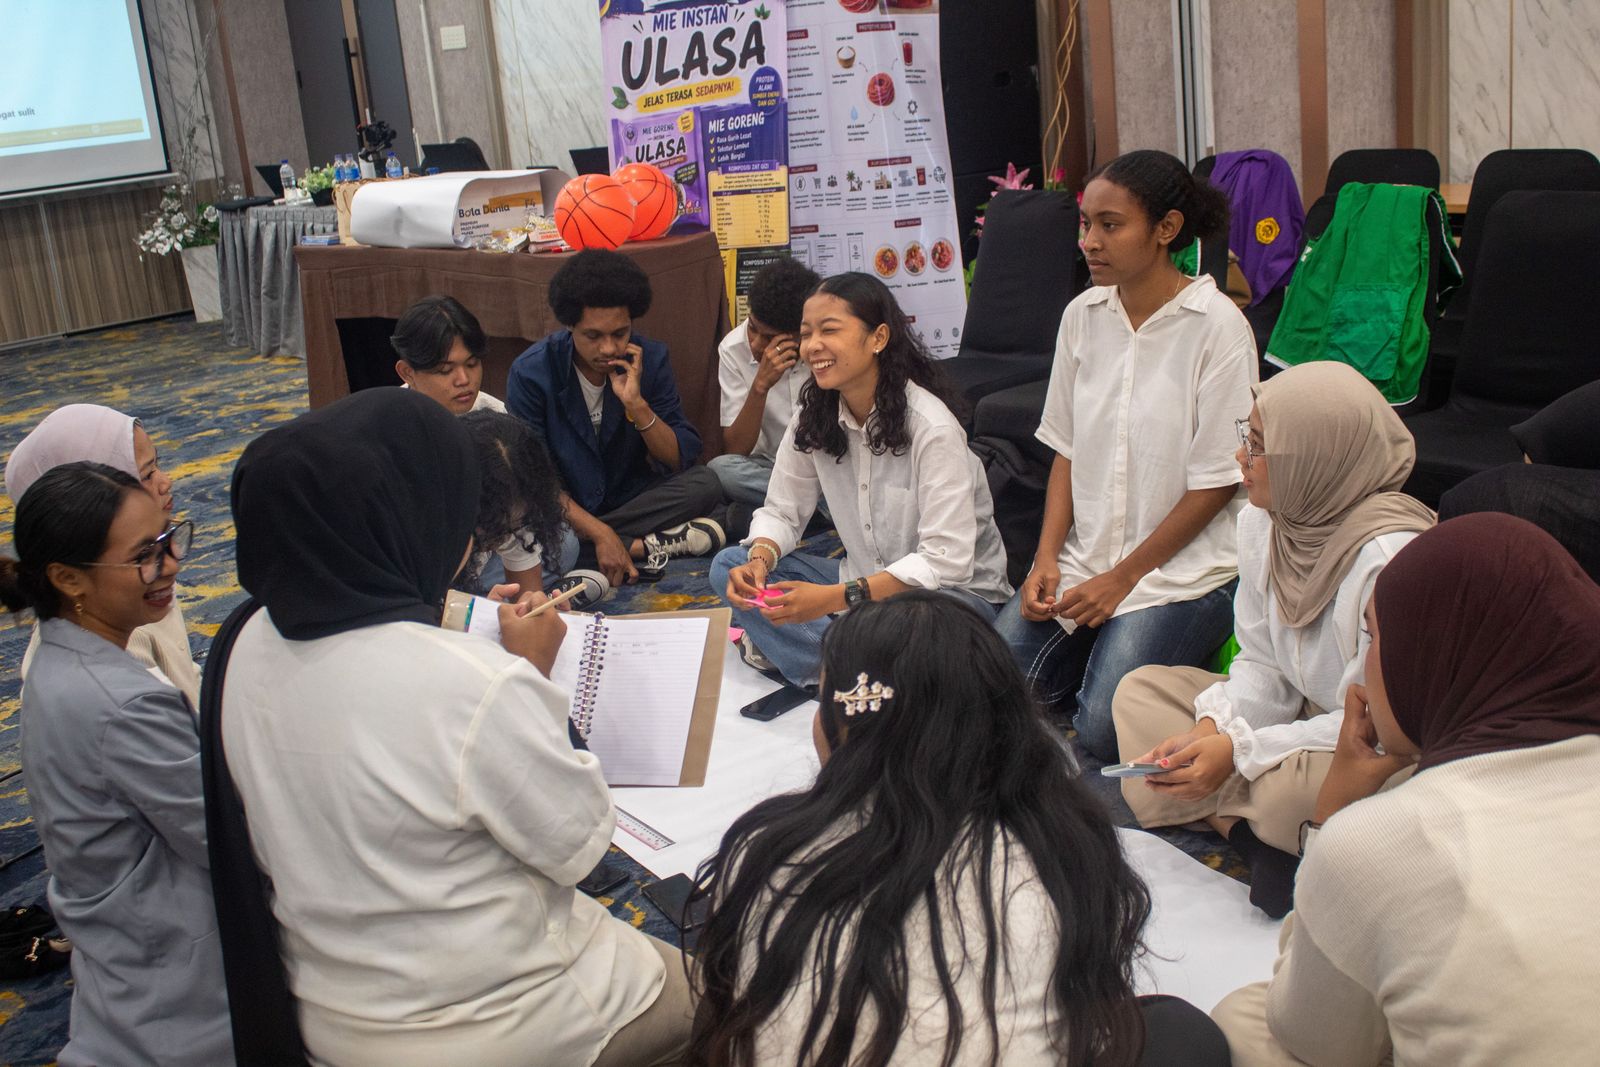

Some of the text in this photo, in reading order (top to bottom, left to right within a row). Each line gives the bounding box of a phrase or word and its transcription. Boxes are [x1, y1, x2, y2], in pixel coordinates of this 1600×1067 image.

[652, 4, 729, 33] MIE INSTAN
[621, 20, 766, 91] ULASA
[755, 76, 775, 84] PROTEIN
[757, 83, 773, 91] ALAMI
[643, 82, 735, 109] JELAS TERASA SEDAPNYA!
[0, 108, 36, 120] gat sulit
[708, 119, 725, 134] MIE
[727, 111, 765, 131] GORENG
[642, 123, 674, 135] MIE GORENG
[636, 136, 686, 163] ULASA
[733, 142, 750, 150] Lembut
[717, 155, 730, 163] Lebih
[525, 199, 536, 209] F4
[458, 203, 510, 218] Bola Dunia
